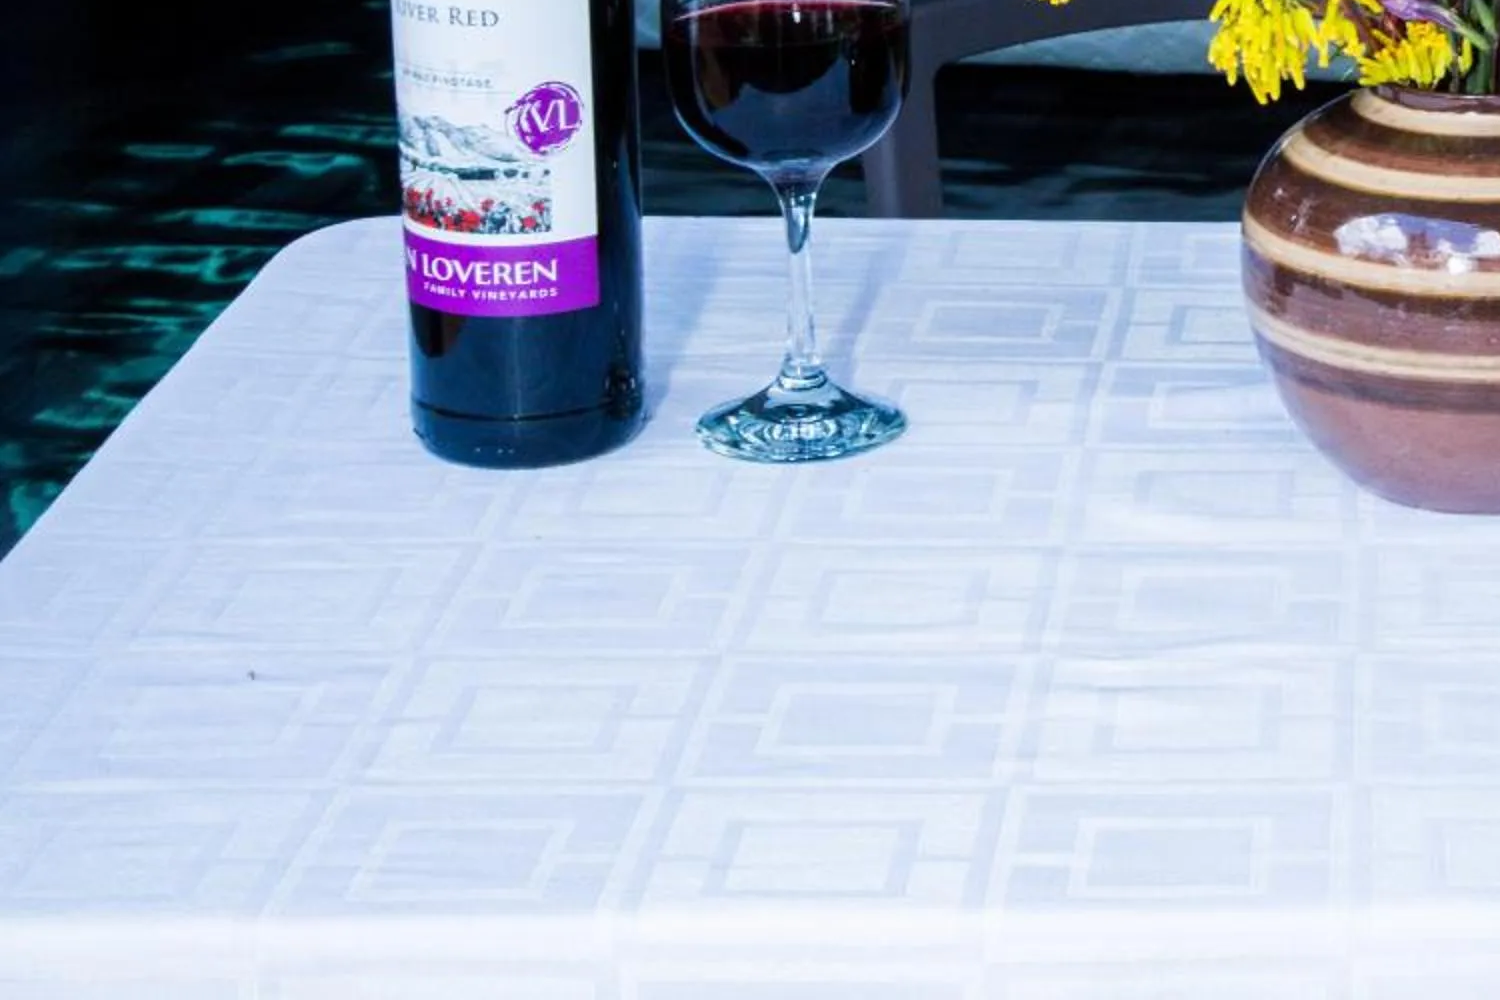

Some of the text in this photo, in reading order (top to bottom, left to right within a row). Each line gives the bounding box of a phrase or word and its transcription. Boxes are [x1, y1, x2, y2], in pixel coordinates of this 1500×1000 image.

[448, 6, 499, 27] RED
[421, 253, 558, 286] LOVEREN
[423, 280, 558, 301] FAMILY VINEYARDS
